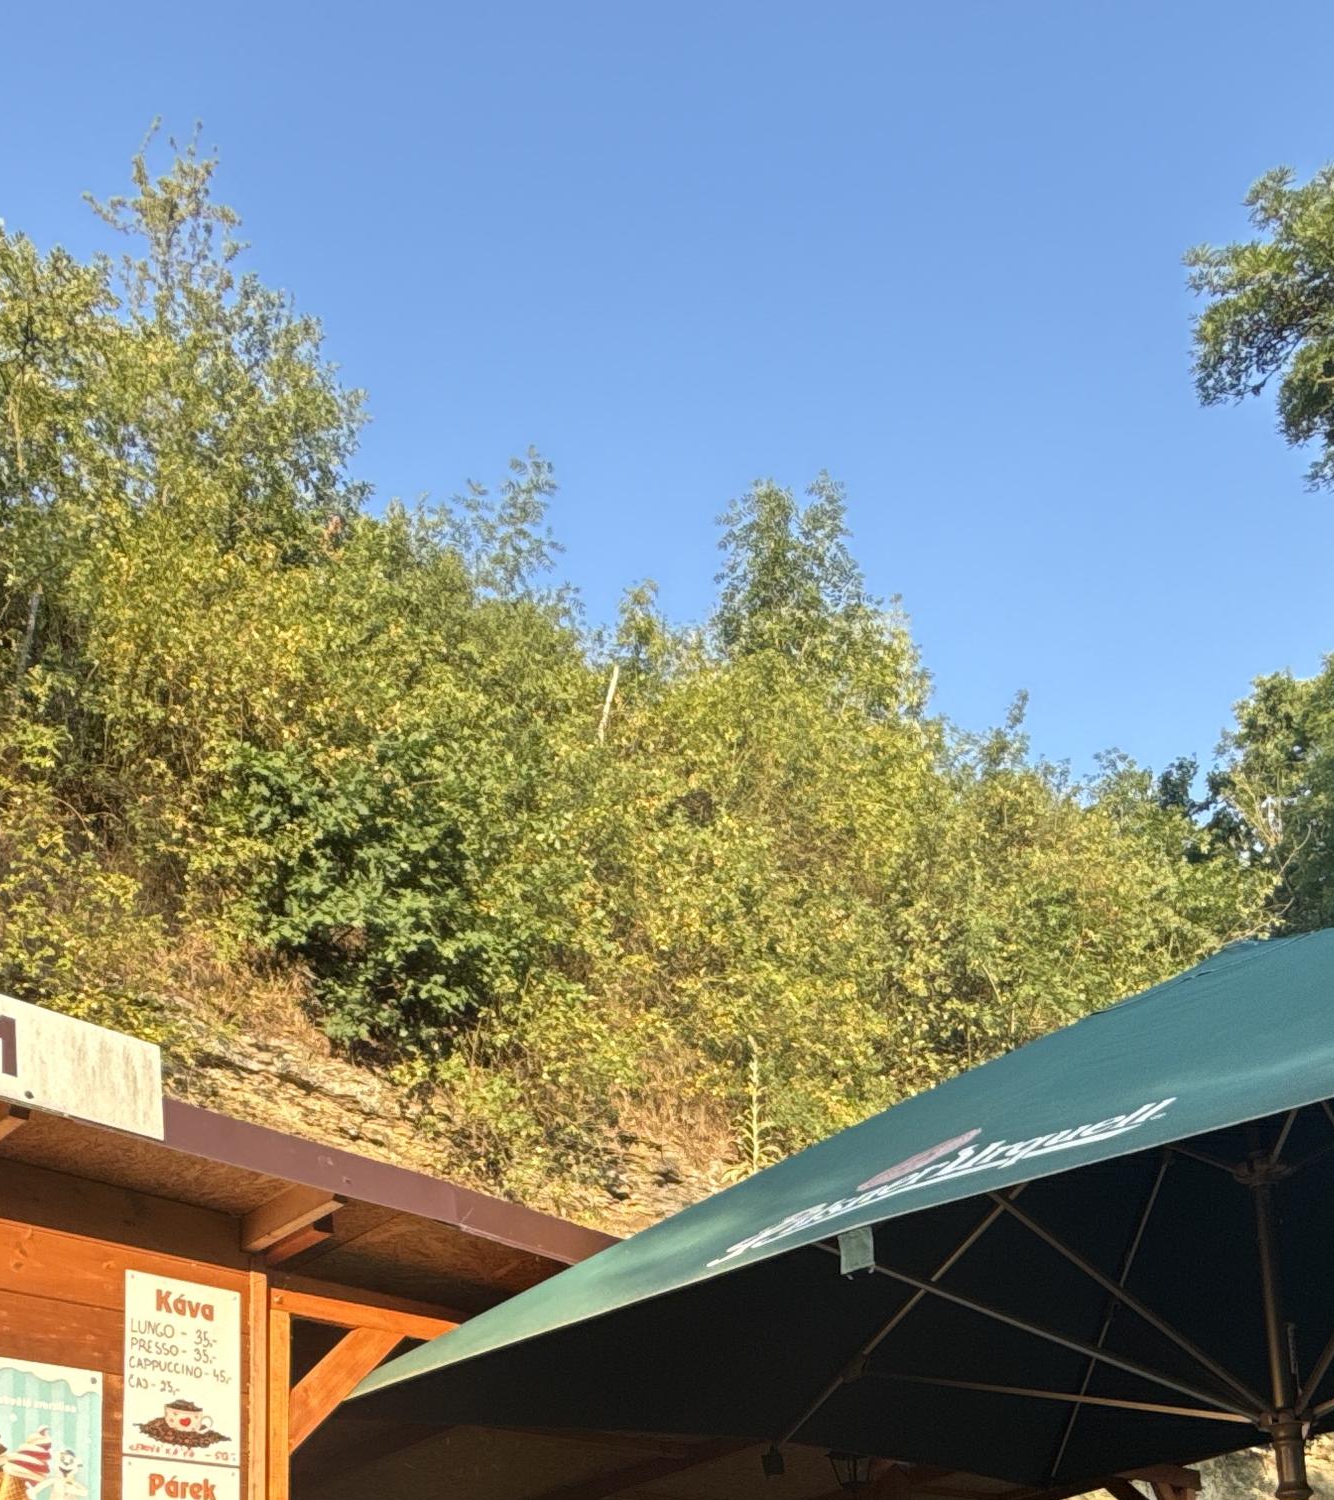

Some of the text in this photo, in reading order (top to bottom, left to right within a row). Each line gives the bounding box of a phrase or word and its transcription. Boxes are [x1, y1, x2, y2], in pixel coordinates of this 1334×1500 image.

[155, 1288, 215, 1322] Káva
[130, 1317, 175, 1339] LUNGO
[130, 1337, 179, 1356] PRESSO
[128, 1356, 202, 1378] CAPPUCCINO
